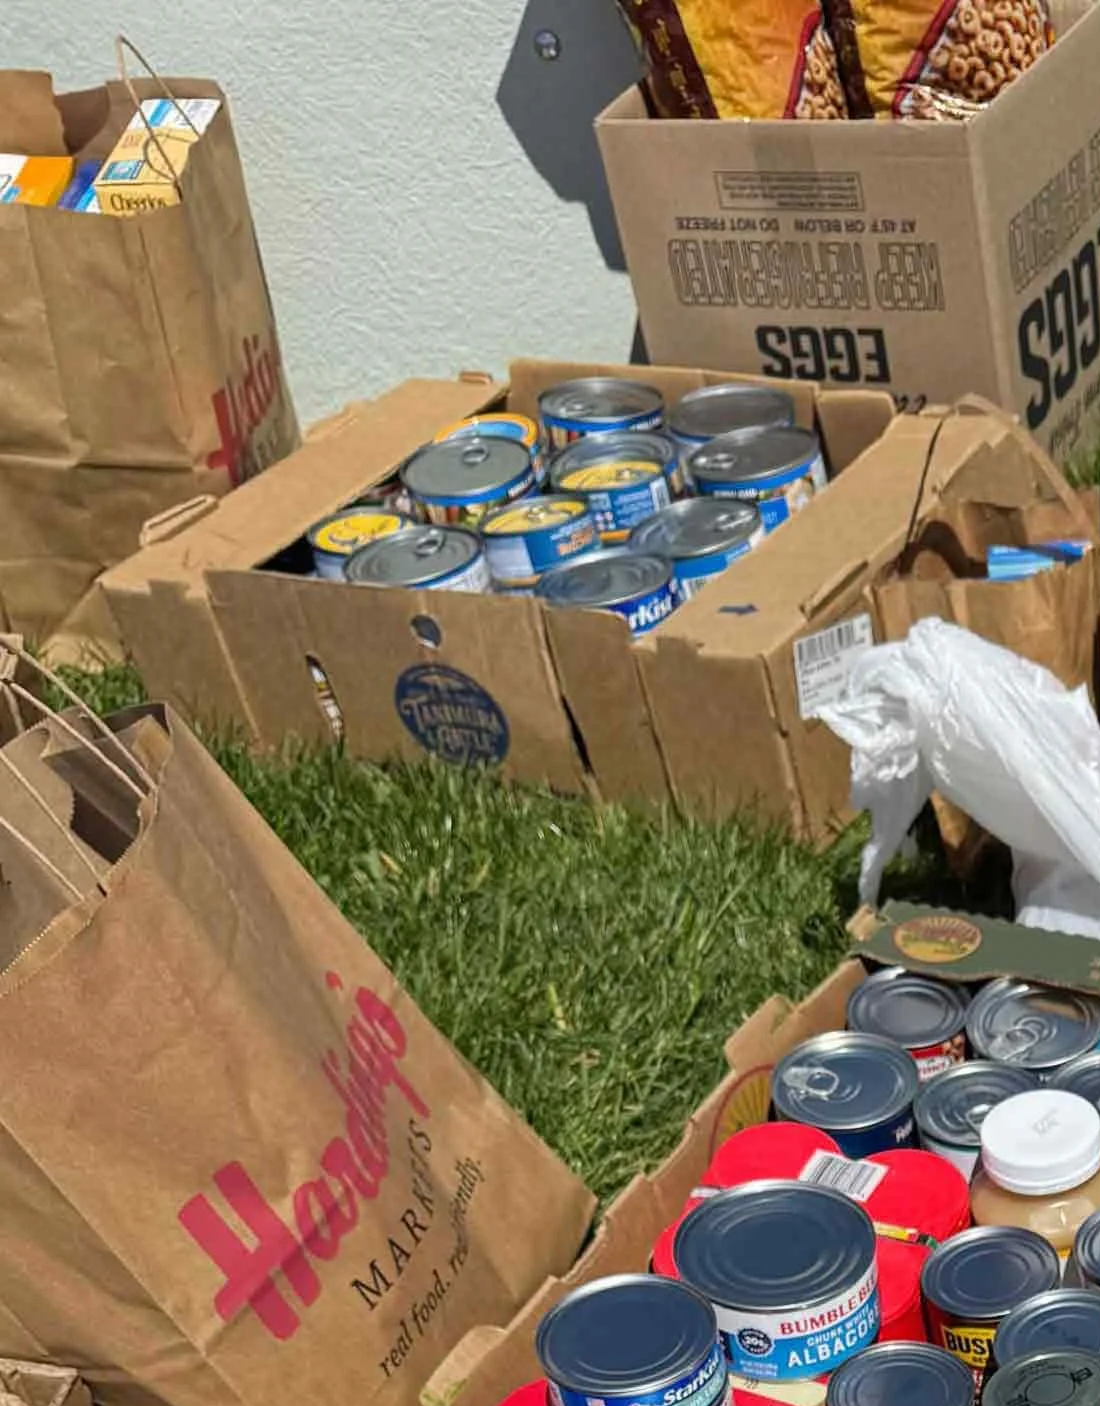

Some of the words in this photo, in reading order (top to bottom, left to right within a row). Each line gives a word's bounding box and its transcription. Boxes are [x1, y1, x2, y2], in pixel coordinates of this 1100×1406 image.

[668, 239, 871, 310] REFRIGERATED
[875, 242, 946, 311] KEEP
[756, 326, 890, 384] EGGS
[780, 1298, 857, 1336] BUMBLE
[945, 1328, 994, 1355] BUS
